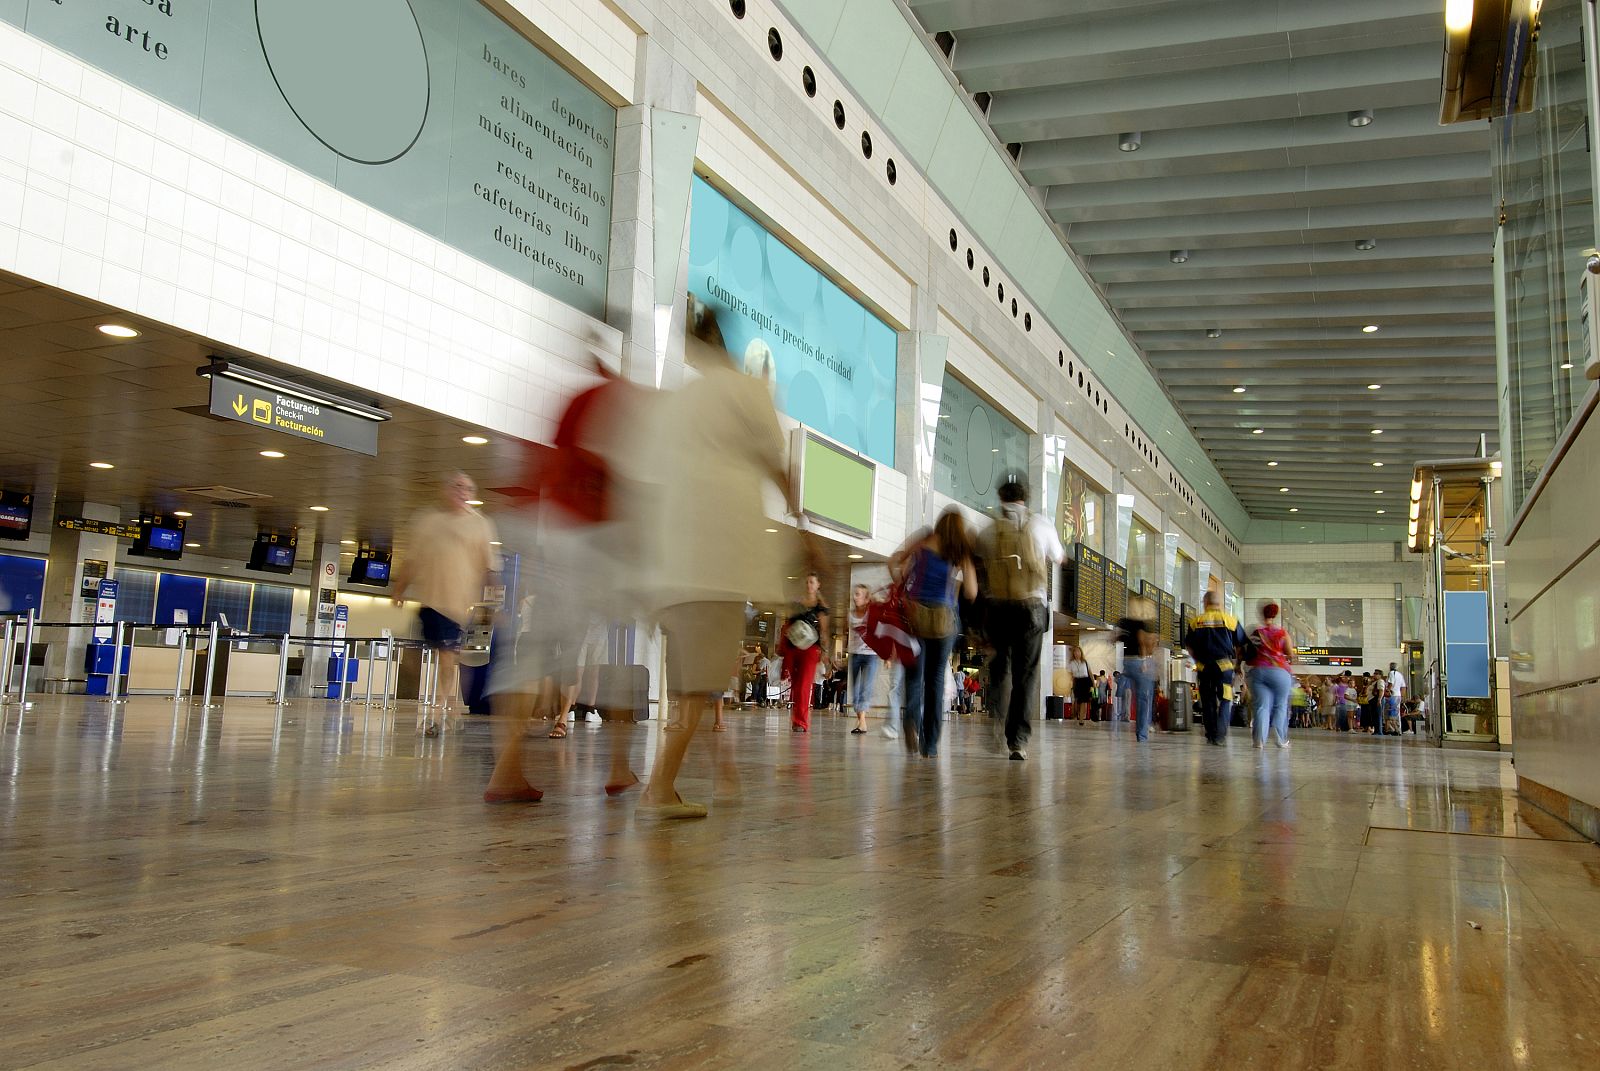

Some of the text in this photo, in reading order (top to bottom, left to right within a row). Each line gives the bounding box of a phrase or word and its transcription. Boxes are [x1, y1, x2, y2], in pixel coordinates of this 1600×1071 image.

[105, 15, 168, 60] arte
[482, 43, 609, 150] bares deportes
[500, 95, 593, 168] alimentación
[479, 113, 606, 207] música regalos
[496, 160, 589, 227] restauración
[473, 182, 603, 266] cafeterías libros
[494, 225, 584, 286] delicatessen
[706, 275, 852, 381] Compra aquí a precios de ciudad
[275, 406, 304, 421] Check-in
[275, 416, 324, 437] Facturación
[276, 395, 320, 415] Facturació
[22, 494, 30, 505] 4
[177, 519, 184, 530] 5
[289, 537, 296, 547] 6
[385, 553, 392, 562] 7
